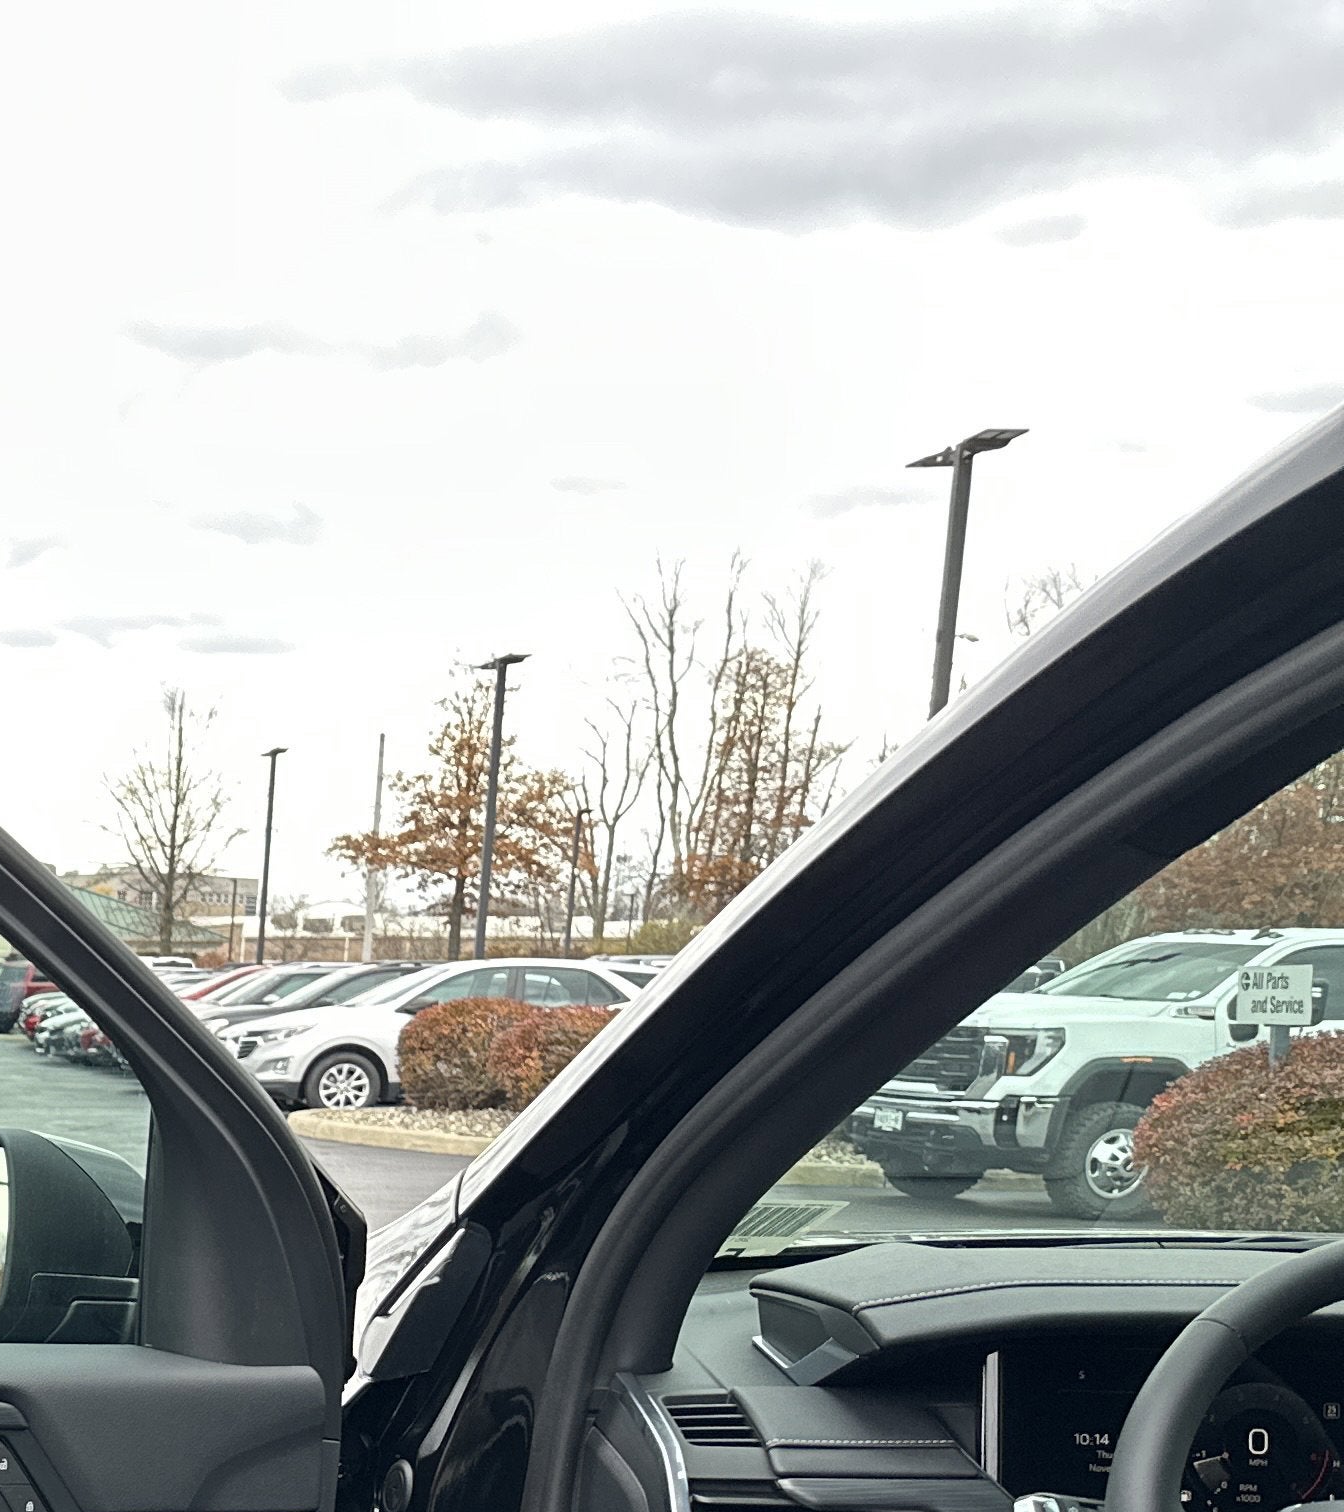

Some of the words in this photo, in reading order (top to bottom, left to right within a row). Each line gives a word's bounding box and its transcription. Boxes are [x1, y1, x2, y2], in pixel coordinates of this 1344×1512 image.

[1252, 972, 1264, 990] All
[1266, 972, 1289, 990] Parts
[1251, 996, 1267, 1014] and
[1270, 996, 1304, 1014] Service
[1073, 1432, 1110, 1446] 10:14
[1248, 1428, 1269, 1455] 0
[1248, 1458, 1268, 1467] MPH
